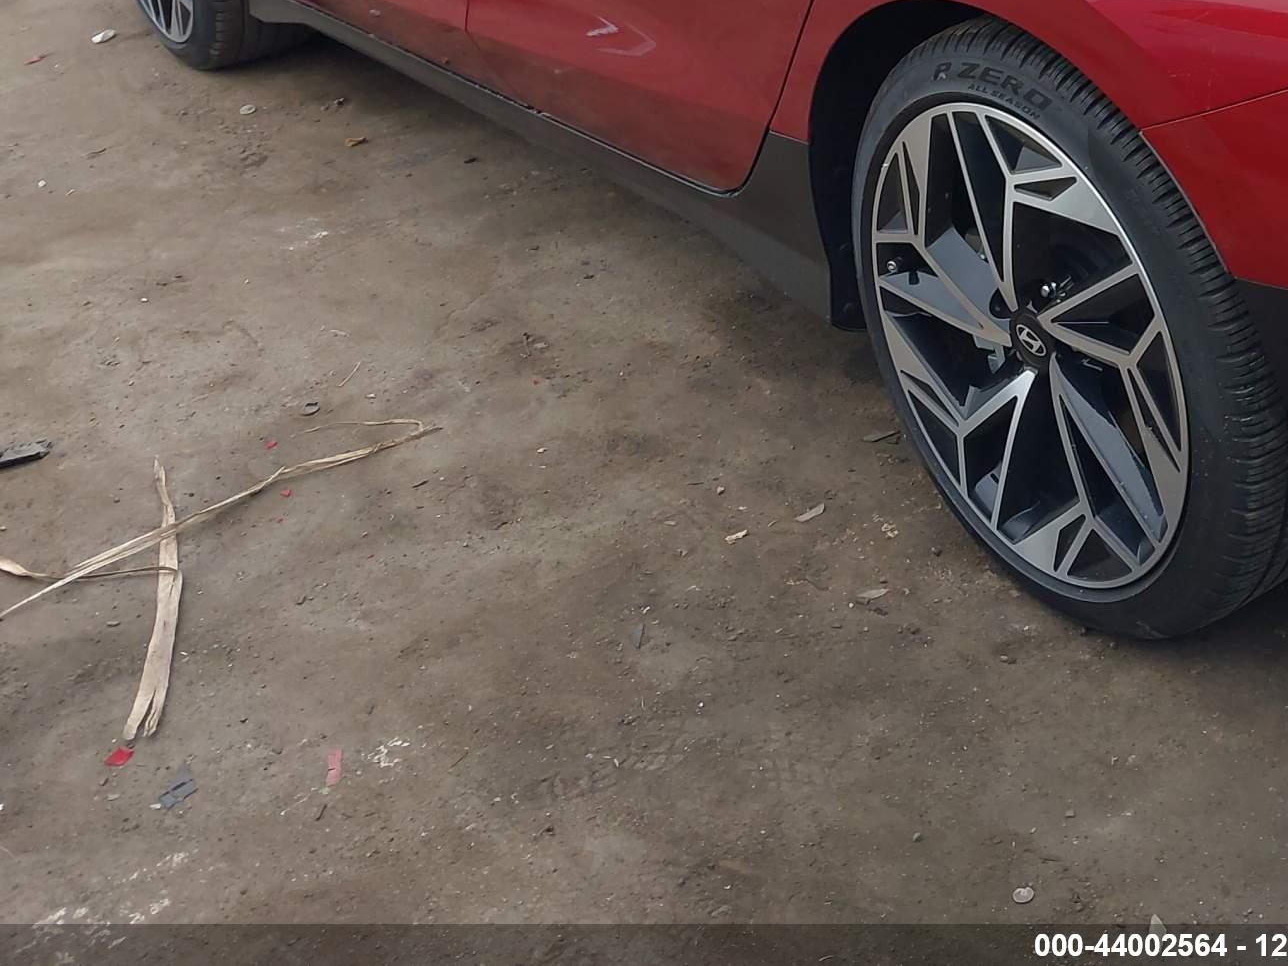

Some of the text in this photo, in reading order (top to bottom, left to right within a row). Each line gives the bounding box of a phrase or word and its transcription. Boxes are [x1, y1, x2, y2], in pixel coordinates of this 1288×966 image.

[933, 62, 1053, 111] P ZERO
[967, 83, 988, 94] ALL
